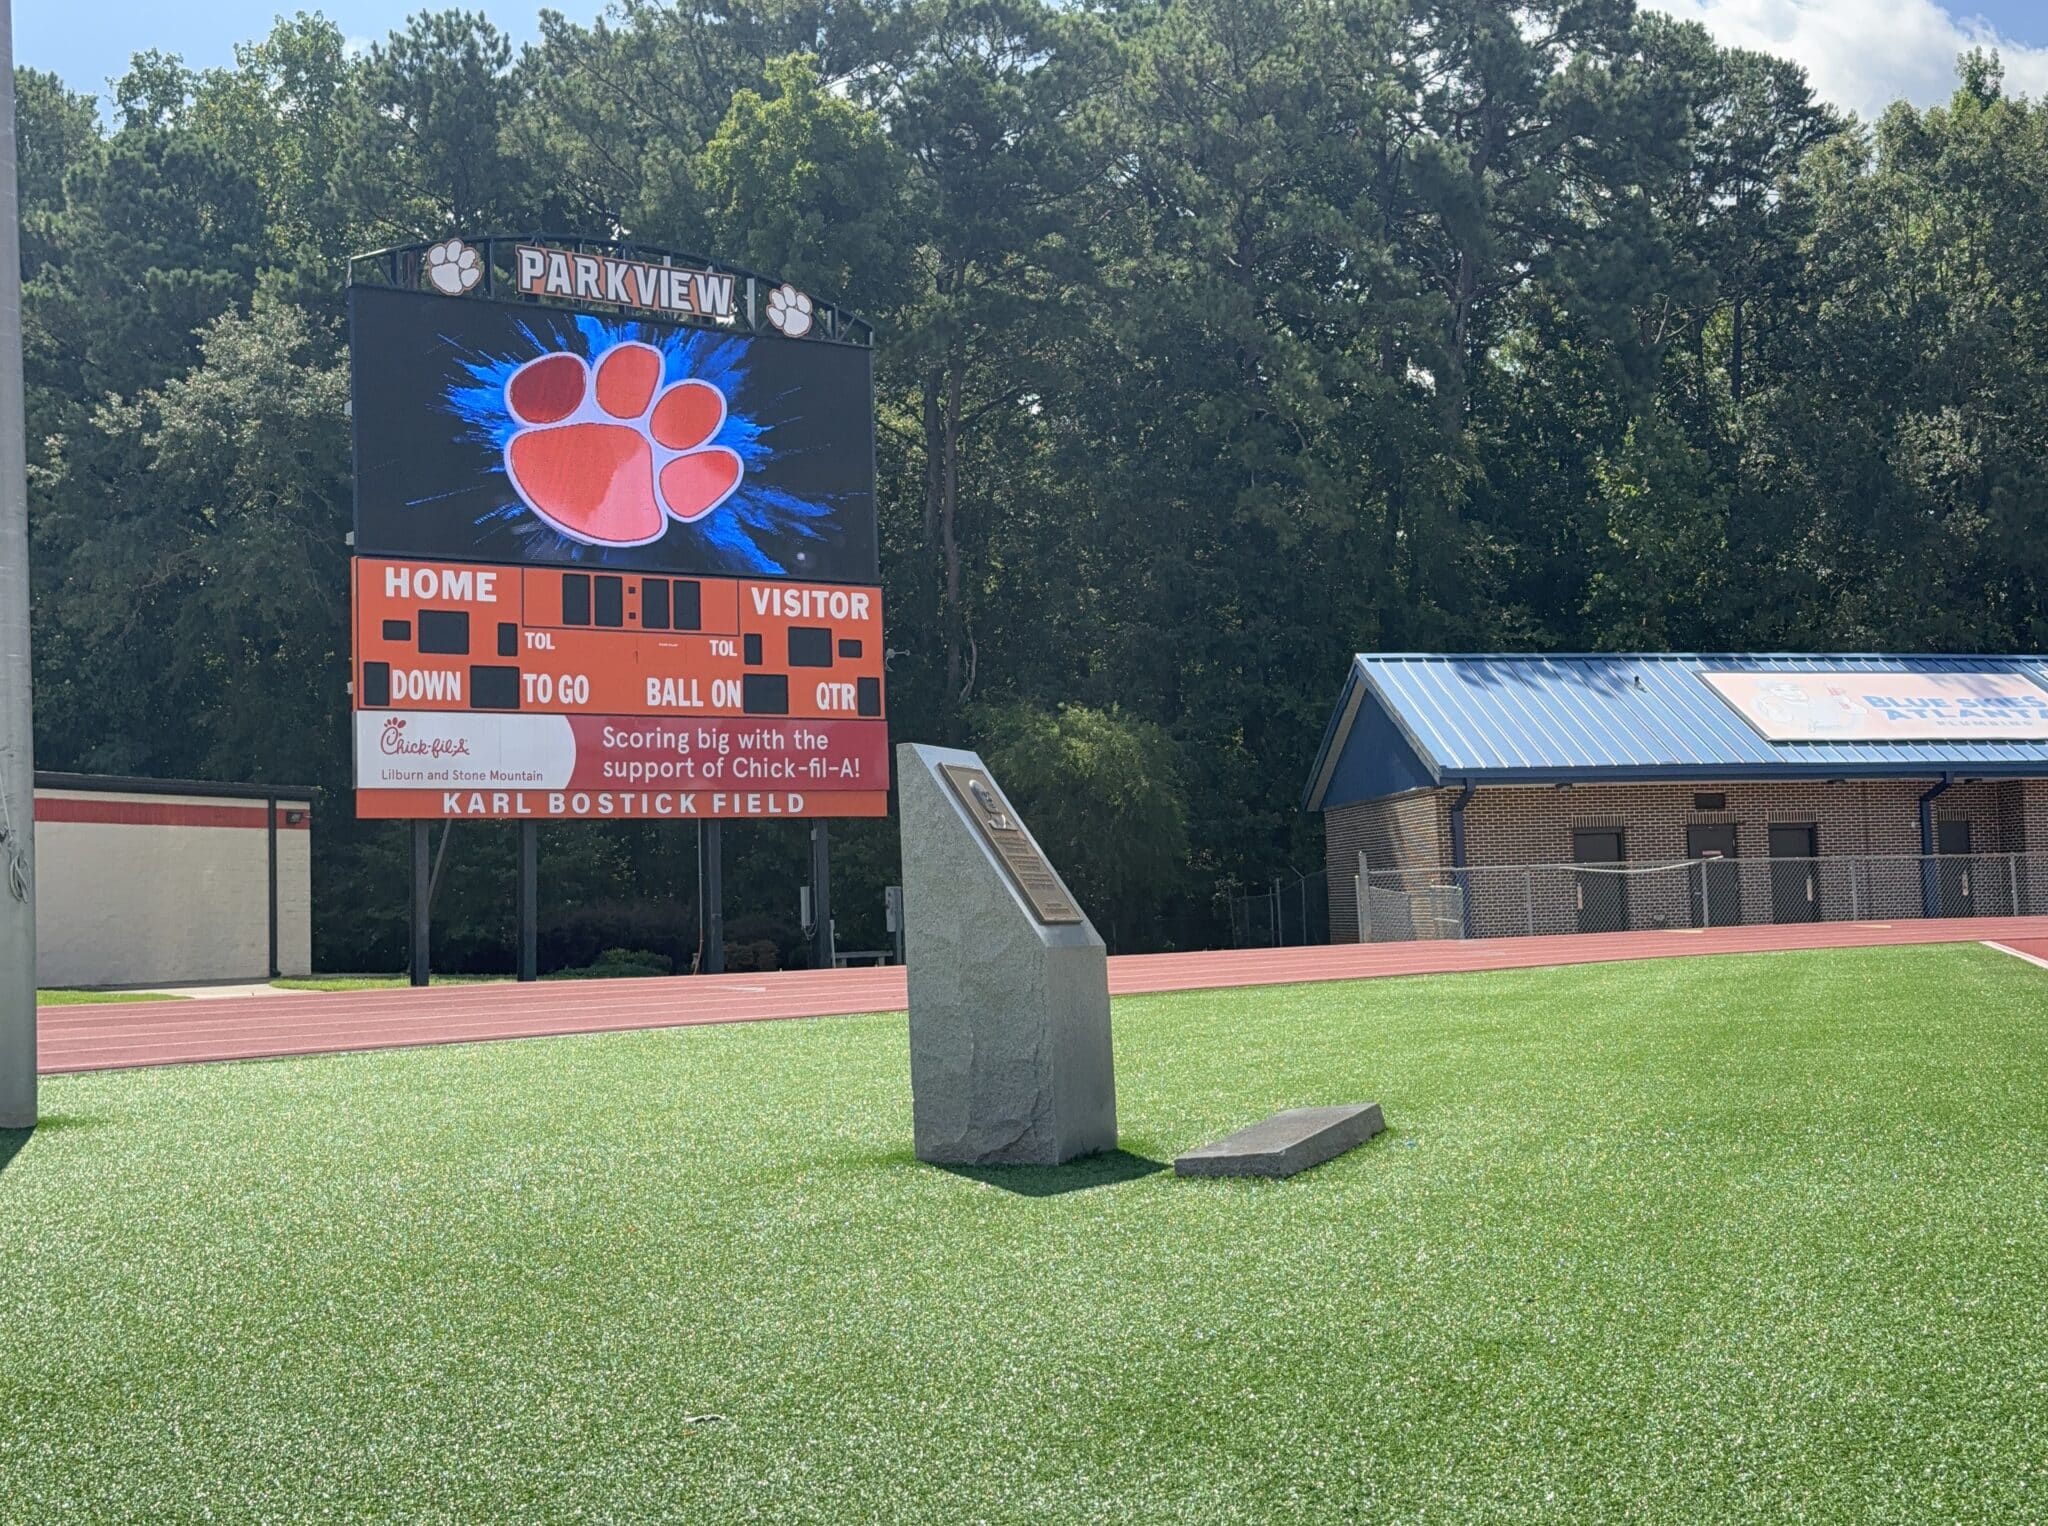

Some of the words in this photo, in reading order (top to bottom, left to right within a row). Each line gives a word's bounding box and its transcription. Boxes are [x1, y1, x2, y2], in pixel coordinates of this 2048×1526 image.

[519, 248, 733, 317] PARKVIEW
[385, 566, 497, 602] HOME
[751, 587, 869, 620] VISITOR
[524, 632, 555, 650] TOL
[709, 640, 737, 657] TOL
[392, 669, 461, 701] DOWN
[523, 673, 553, 704] TO
[558, 674, 590, 705] GO
[646, 677, 704, 707] BALL
[711, 679, 741, 708] ON
[816, 682, 856, 710] QTR
[1862, 695, 1952, 708] BLUE
[1955, 695, 2047, 708] SKIES
[380, 718, 470, 758] Chick-fil-A
[602, 726, 690, 754] Scoring
[698, 728, 730, 754] big
[738, 728, 785, 750] with
[793, 730, 829, 750] the
[381, 769, 424, 780] Lilburn
[427, 769, 449, 781] and
[452, 770, 486, 781] Stone
[490, 770, 543, 781] Mountain
[602, 759, 695, 783] support
[702, 757, 724, 778] of
[732, 757, 861, 779] Chick-fil-A!
[443, 792, 531, 814] KARL
[549, 792, 697, 814] BOSTICK
[713, 793, 805, 815] FIELD
